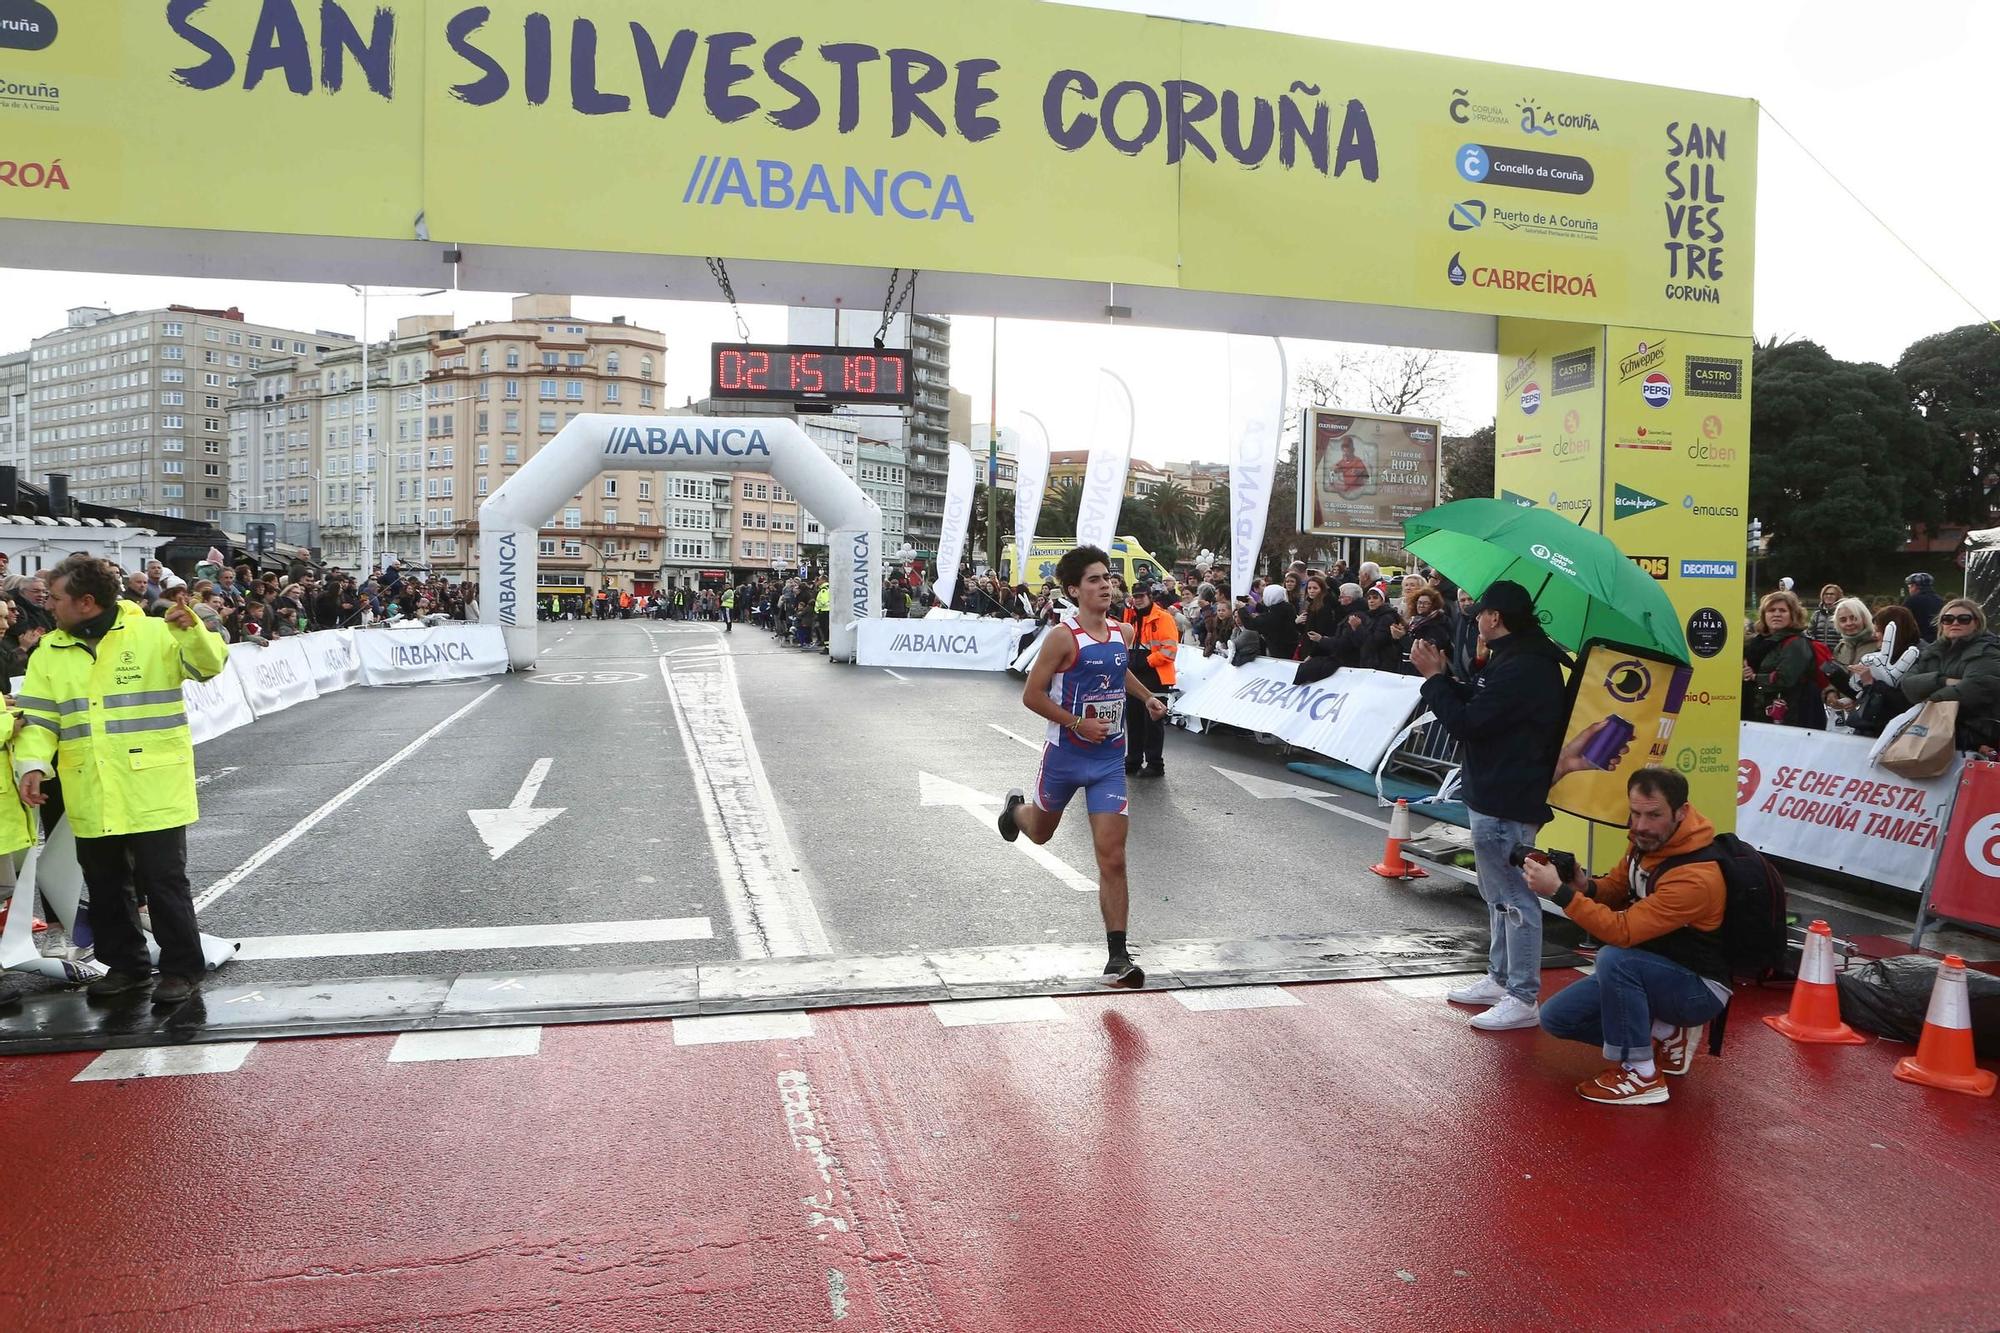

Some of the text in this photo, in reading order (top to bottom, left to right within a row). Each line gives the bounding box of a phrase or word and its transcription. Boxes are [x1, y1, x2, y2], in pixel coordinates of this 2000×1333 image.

[0, 19, 39, 33] ruña
[166, 0, 1380, 183] SAN SILVESTRE CORUÑA
[1666, 121, 1726, 161] SAN
[1494, 161, 1584, 182] Concello da Coruña
[1665, 160, 1725, 204] SIL
[1494, 208, 1598, 231] Puerto de A Coruña
[1664, 201, 1724, 244] VES
[1664, 242, 1724, 281] TRE
[1472, 267, 1597, 298] CABREIROÁ
[1665, 284, 1720, 304] CORUÑA
[1559, 363, 1588, 377] CASTRO
[1620, 346, 1665, 381] Schweppes
[1695, 369, 1732, 380] CASTRO
[1521, 393, 1541, 404] PEPSI
[1643, 385, 1671, 396] PEPSI
[1553, 435, 1590, 457] deben
[1688, 437, 1736, 460] deben
[1391, 459, 1420, 471] RODY
[1693, 505, 1739, 516] emalcsa
[1549, 560, 1577, 576] cuenta
[1553, 552, 1574, 565] cada
[1634, 559, 1666, 575] DIS
[1683, 563, 1734, 575] DECATHLON
[1692, 621, 1722, 629] PINAR
[1702, 612, 1713, 620] EL
[1771, 766, 1927, 817] SE CHE PRESTA,
[1759, 788, 1941, 850] Á CORUÑA TAMÉN
